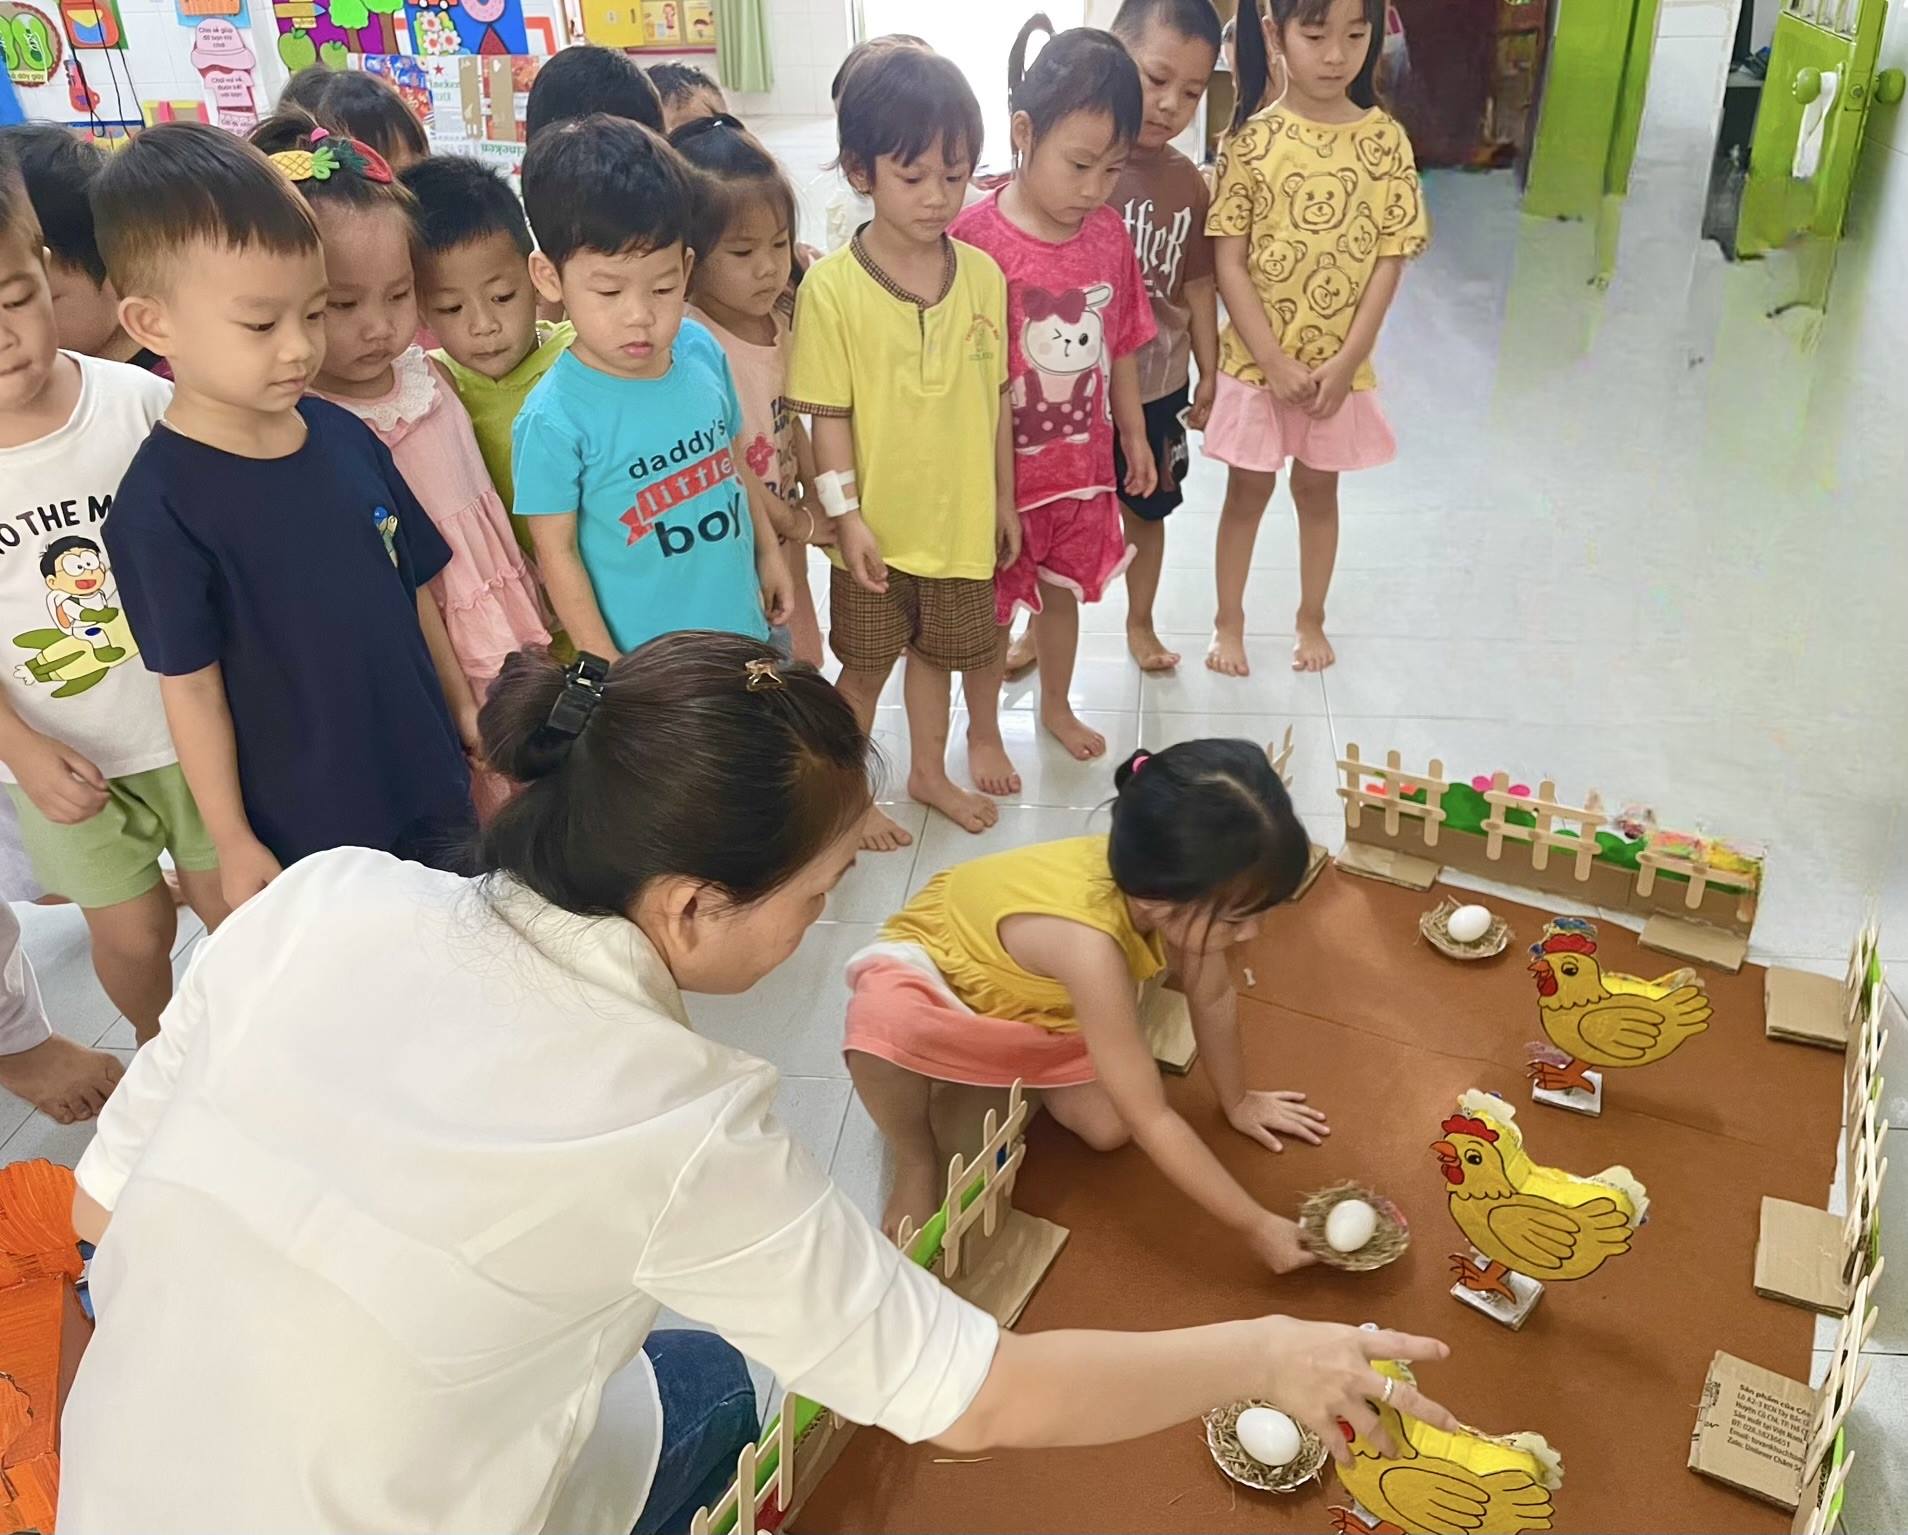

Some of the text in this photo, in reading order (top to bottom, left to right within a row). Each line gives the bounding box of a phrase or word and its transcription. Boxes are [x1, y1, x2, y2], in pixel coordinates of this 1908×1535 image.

[628, 419, 725, 480] daddy's
[643, 456, 733, 512] little
[16, 499, 81, 536] THE
[654, 492, 742, 558] boy
